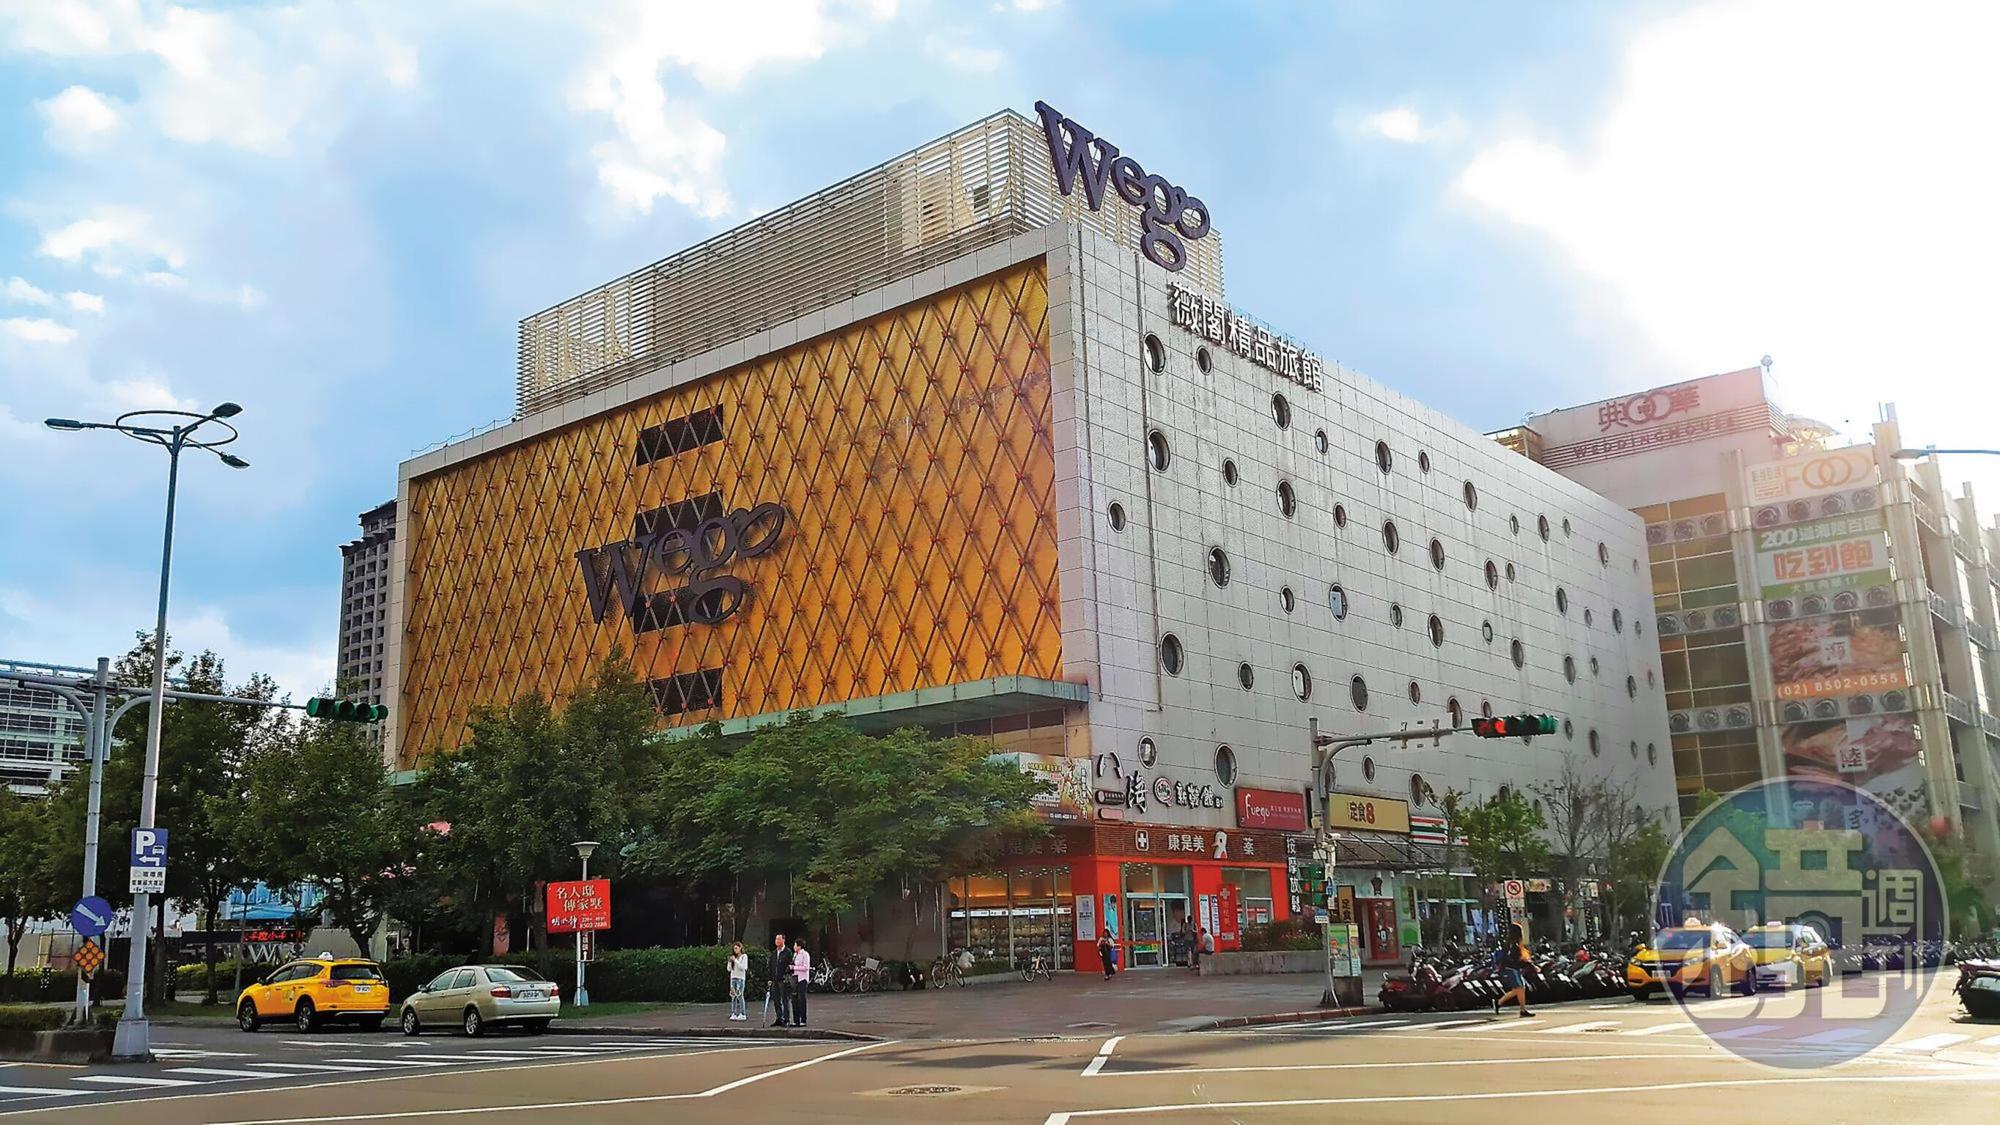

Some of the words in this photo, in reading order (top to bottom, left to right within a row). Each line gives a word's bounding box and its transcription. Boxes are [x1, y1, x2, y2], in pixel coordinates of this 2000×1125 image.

[1035, 100, 1210, 272] Wego
[1168, 281, 1323, 391] 薇閣精品旅館
[574, 502, 784, 625] Wego
[1773, 540, 1873, 580] 吃到飽
[1777, 683, 1808, 698] (02)
[1815, 673, 1898, 692] 8502-0555
[136, 831, 156, 855] P
[1168, 834, 1205, 853] 康是美
